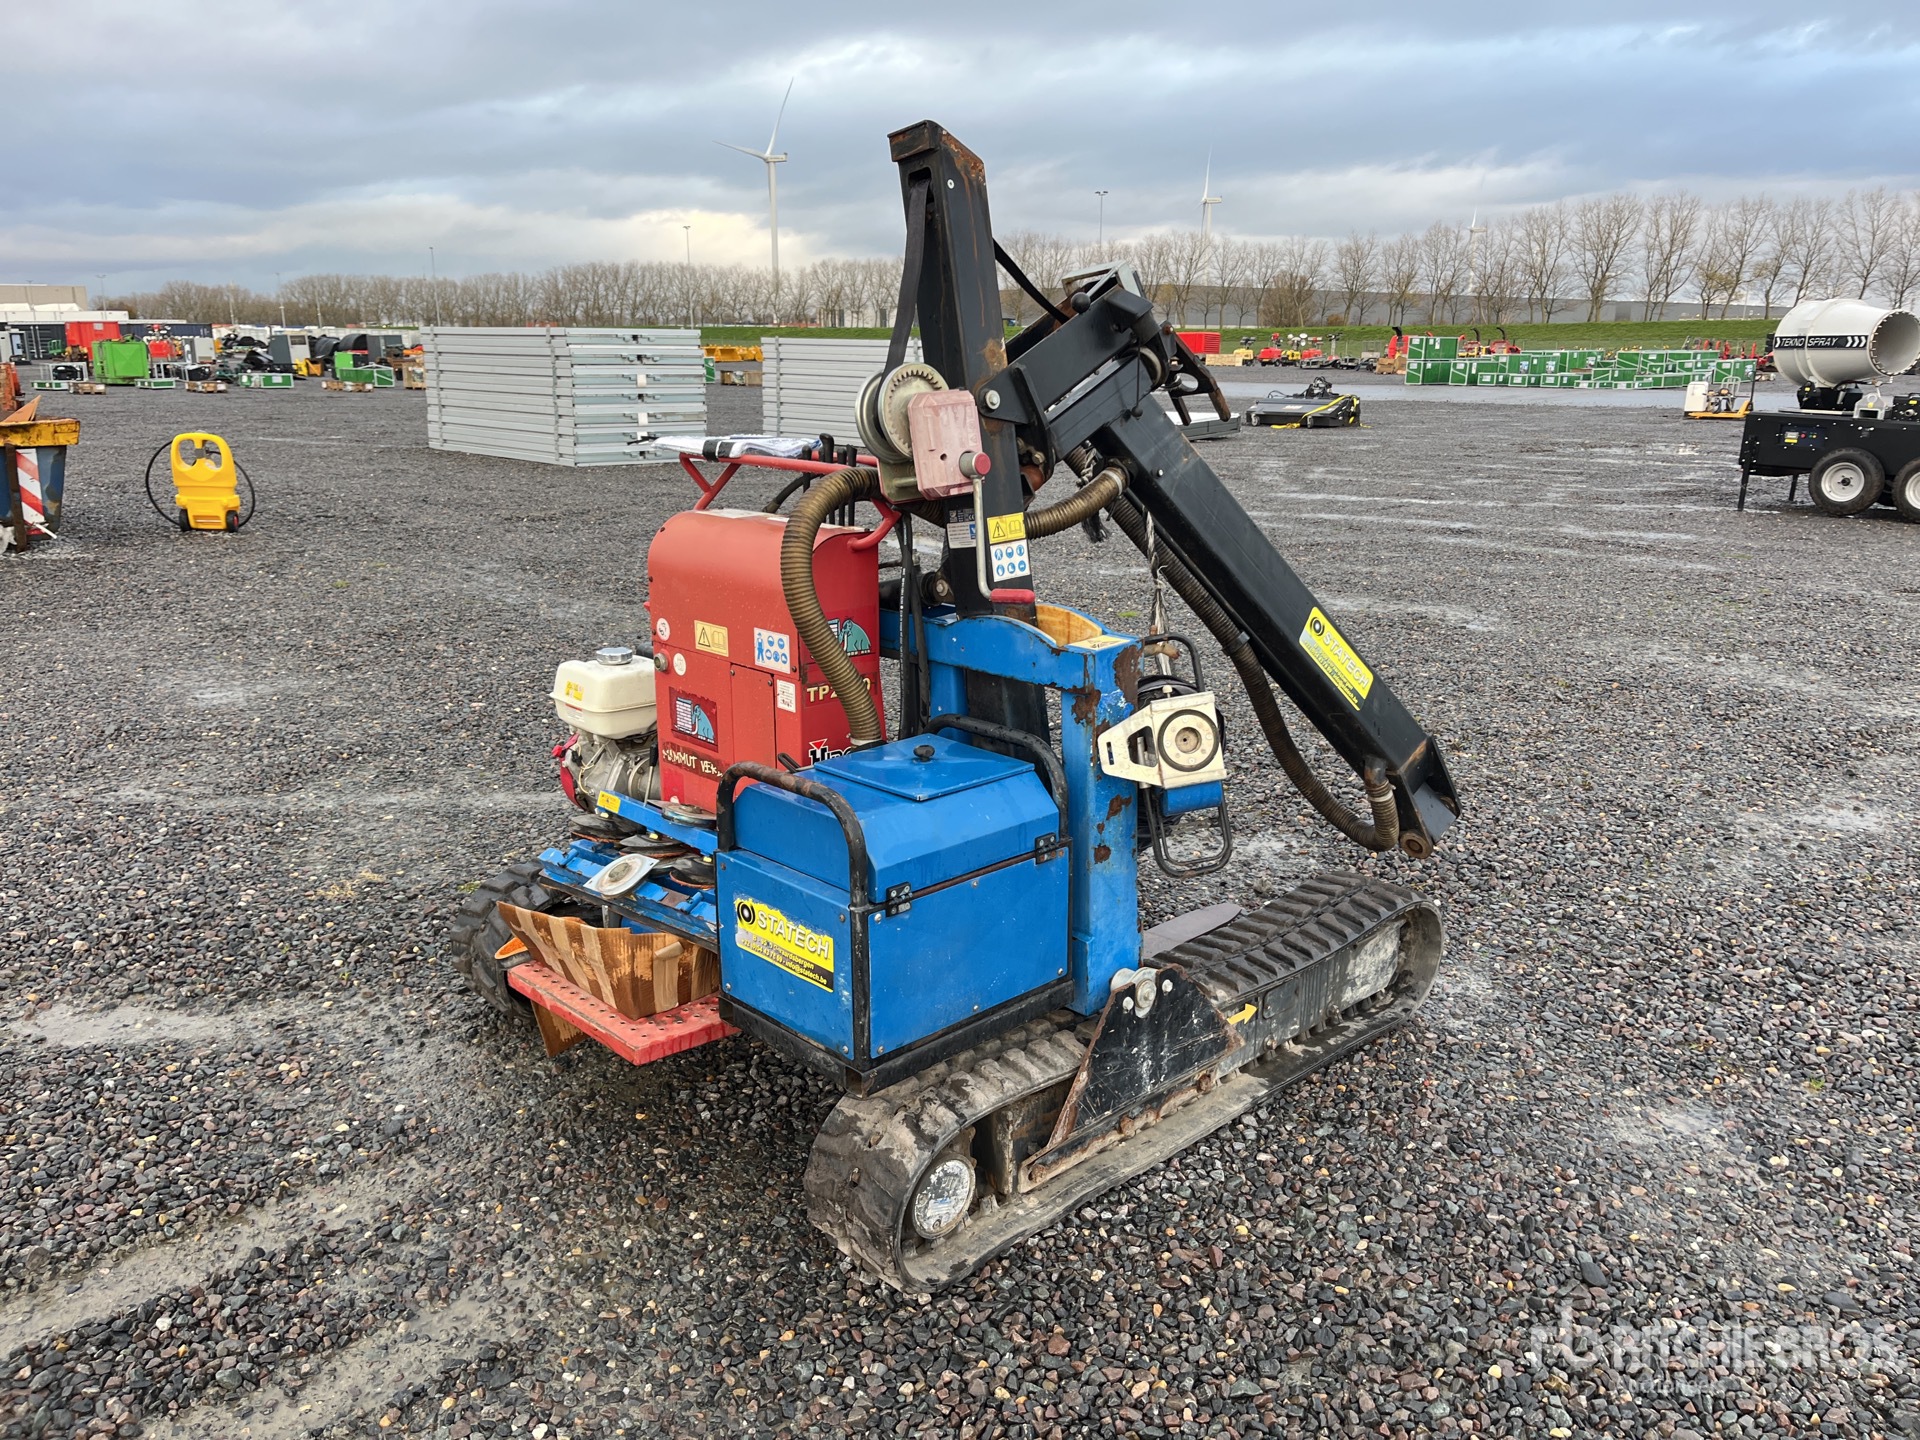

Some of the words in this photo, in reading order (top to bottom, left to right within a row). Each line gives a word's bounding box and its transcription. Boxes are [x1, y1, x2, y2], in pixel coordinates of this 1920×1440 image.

[1781, 337, 1805, 347] TEKNO
[1807, 337, 1838, 347] SPRAY
[1323, 633, 1370, 689] STATECH
[757, 910, 830, 960] STATECH
